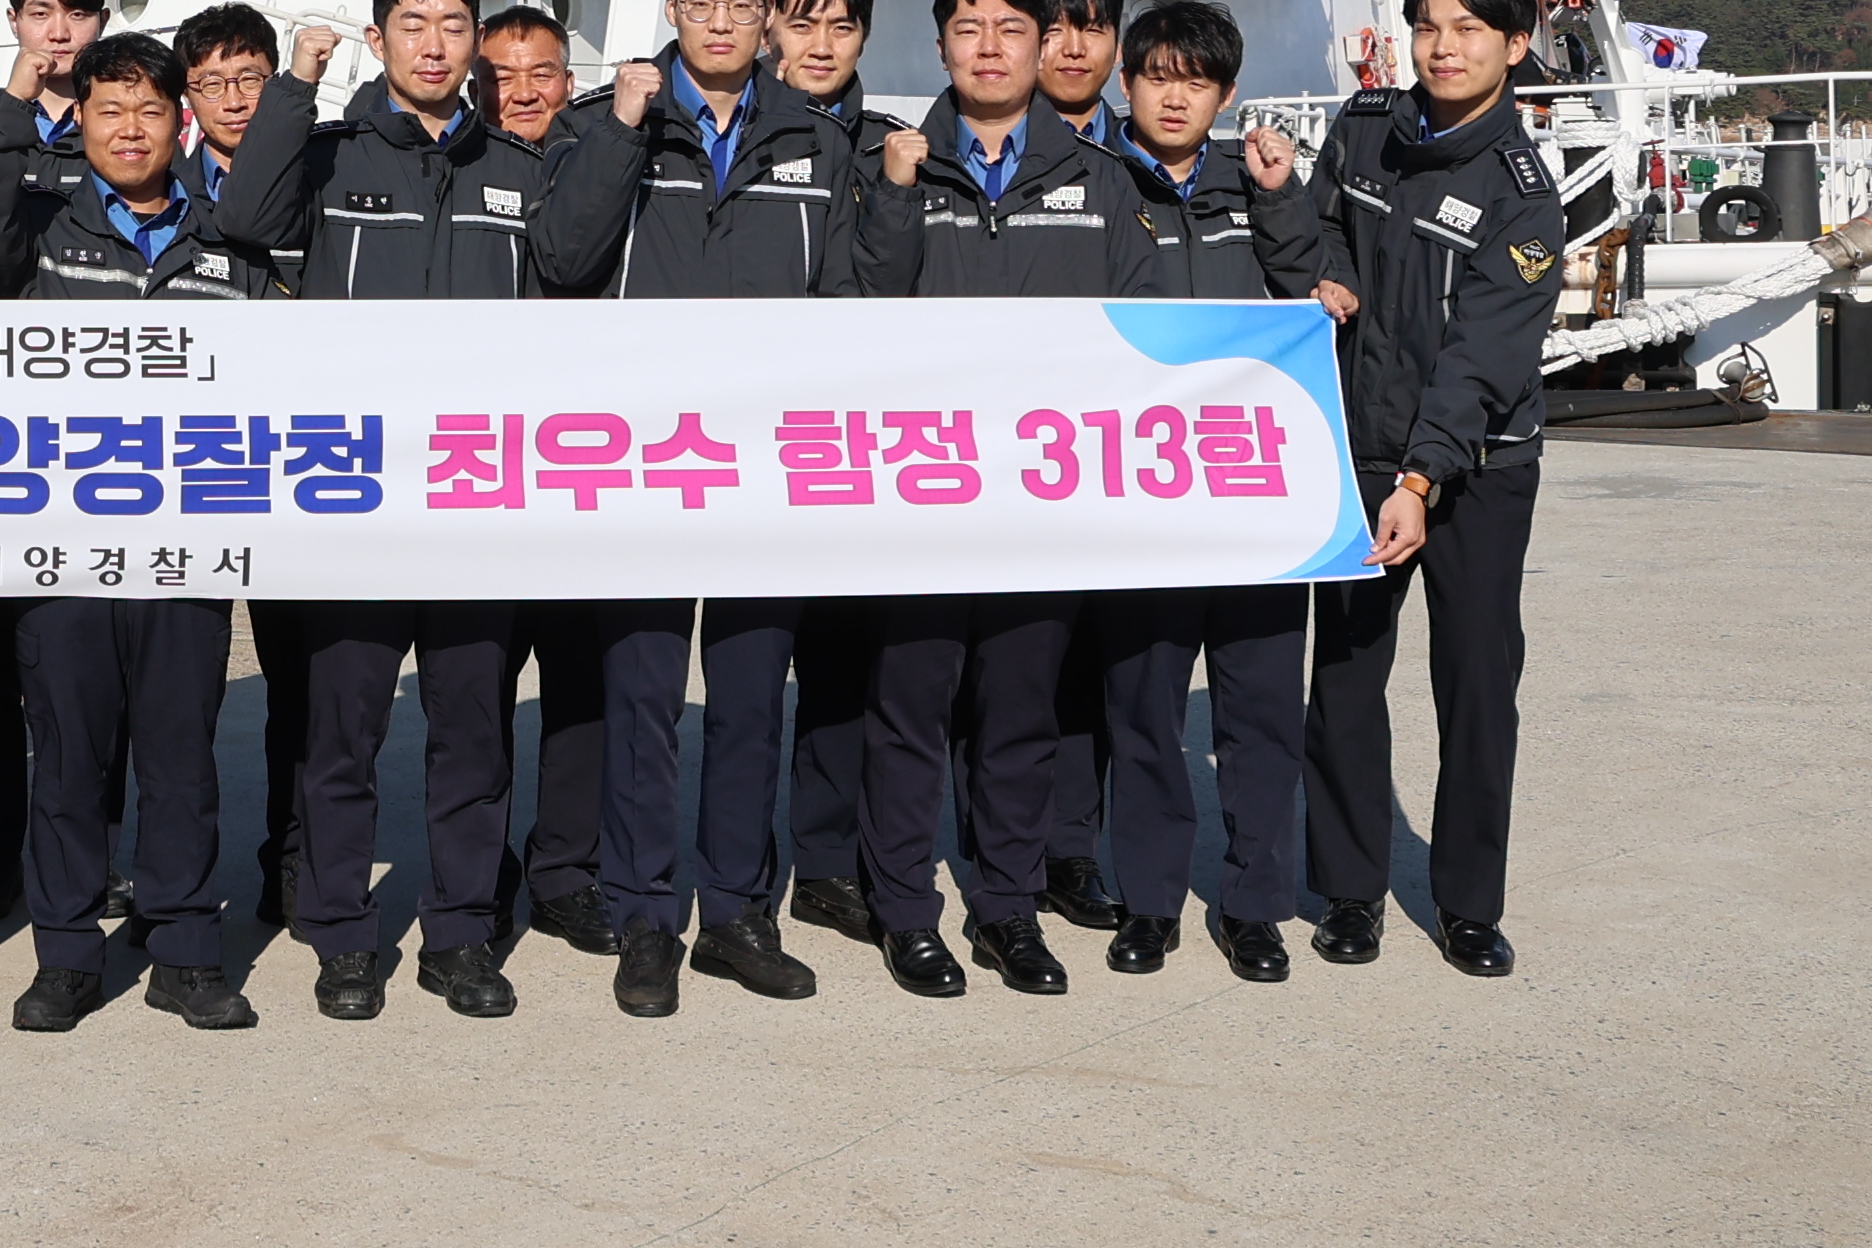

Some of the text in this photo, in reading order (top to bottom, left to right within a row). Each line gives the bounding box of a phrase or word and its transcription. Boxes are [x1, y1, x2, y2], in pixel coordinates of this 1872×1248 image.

[773, 171, 812, 183] POLICE
[486, 202, 522, 216] POLICE
[1043, 200, 1084, 210] POLICE
[1435, 210, 1475, 233] POLICE
[194, 266, 230, 281] POLICE
[426, 412, 740, 511] 최우수
[774, 409, 983, 506] 함정
[1015, 404, 1288, 501] 313함
